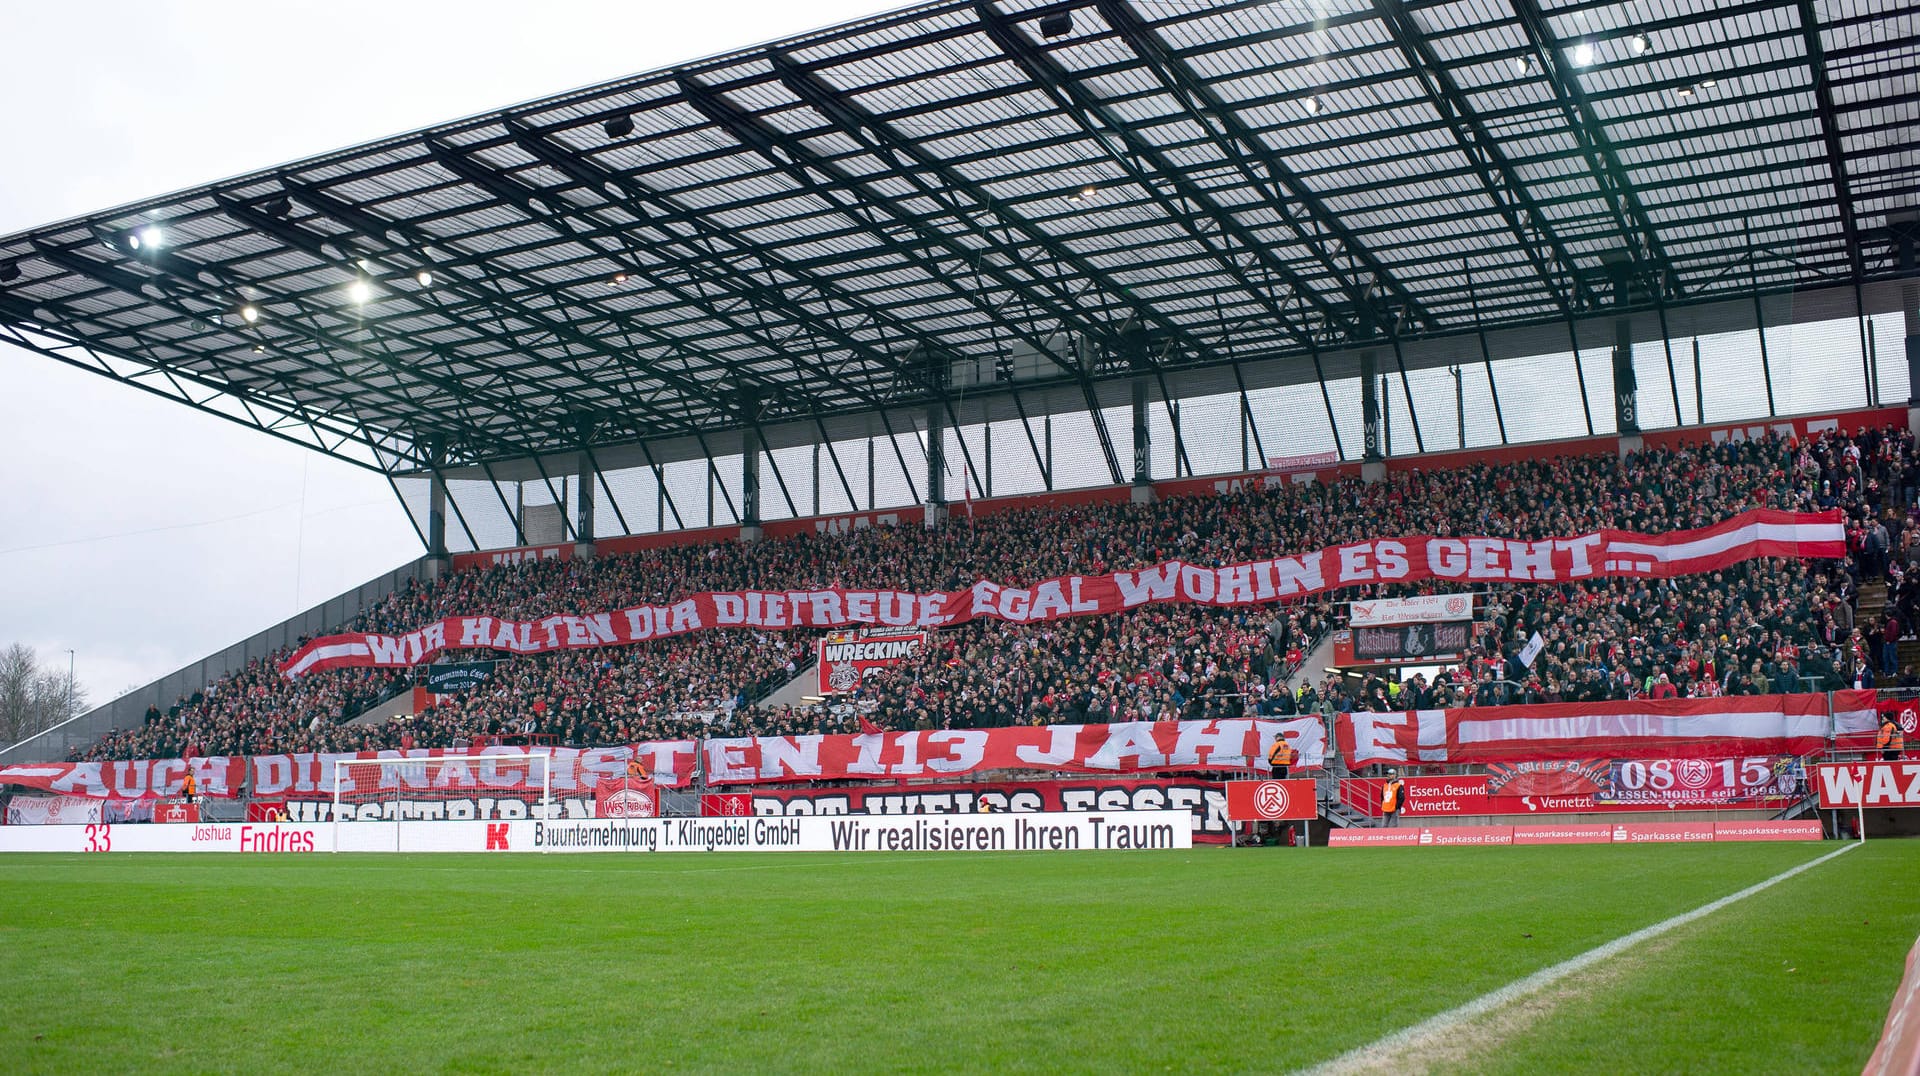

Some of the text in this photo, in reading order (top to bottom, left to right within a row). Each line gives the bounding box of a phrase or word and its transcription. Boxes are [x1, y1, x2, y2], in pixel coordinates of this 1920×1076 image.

[366, 621, 446, 664] WIR
[460, 613, 617, 651] HALTEN
[625, 599, 702, 640] DIR
[971, 577, 1099, 621] EGAL
[1114, 551, 1325, 604] WOHIN
[1338, 541, 1410, 583] ES
[51, 756, 231, 798] AUCH
[253, 752, 356, 794] DIE
[847, 731, 989, 773] 113
[1618, 788, 1708, 800] ESSEN-HORST
[1712, 787, 1737, 798] seit
[1409, 800, 1461, 812] Vernetzt.
[1540, 796, 1595, 808] Vernetzt.
[663, 820, 674, 846] T.
[679, 819, 750, 851] Klingebiel
[755, 818, 801, 845] GmbH
[831, 817, 1174, 850] Wir realisieren Ihren Traum
[1514, 829, 1611, 839] www.sparkasse-essen.de
[1631, 831, 1714, 841] Sparkasse Essen
[1715, 826, 1821, 836] www.sparkasse-essen.de
[84, 824, 111, 852] 33
[192, 825, 314, 852] Joshua Endres
[1436, 834, 1512, 844] Sparkasse Essen
